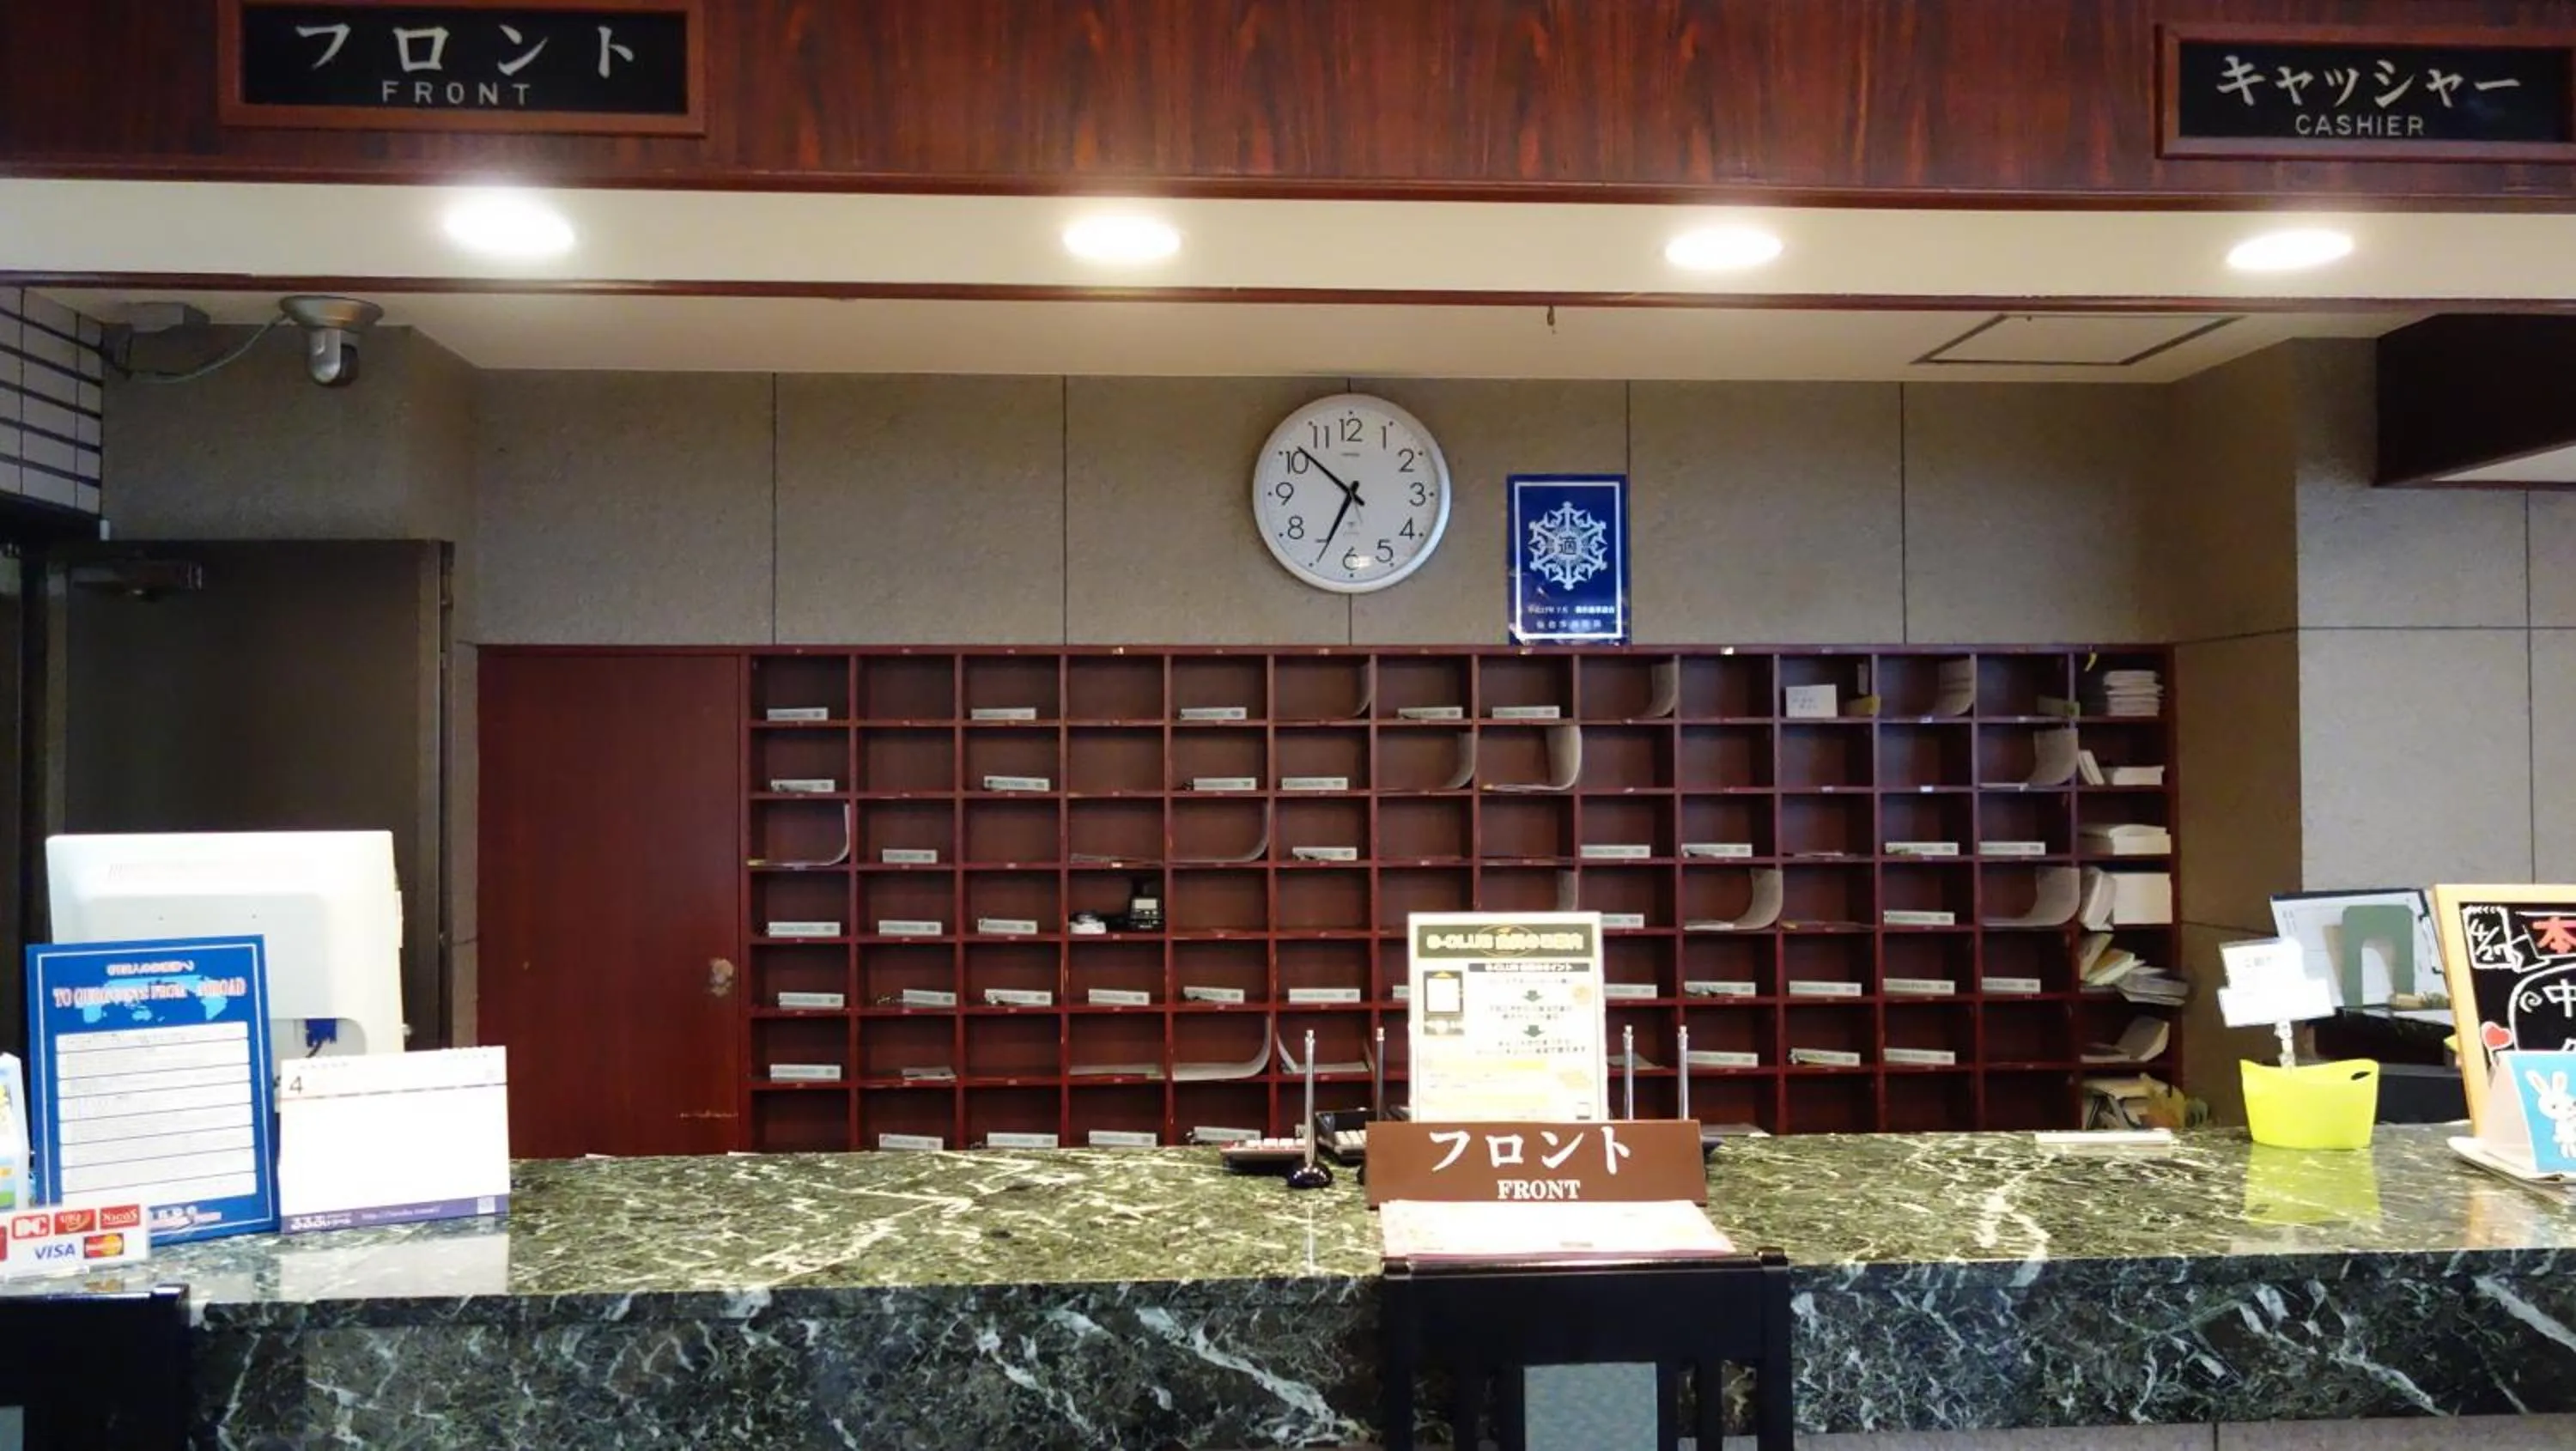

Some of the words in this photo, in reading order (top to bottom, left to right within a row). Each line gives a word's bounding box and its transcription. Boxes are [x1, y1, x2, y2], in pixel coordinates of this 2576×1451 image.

[294, 24, 635, 78] フロント
[381, 80, 532, 106] FRONT
[2215, 54, 2522, 109] キャッシャー
[2293, 112, 2426, 137] CASHIER
[1312, 425, 1330, 449] 11
[1339, 417, 1363, 442] 12
[1380, 425, 1388, 450] 1
[1285, 449, 1309, 475] 10
[1397, 448, 1415, 472] 2
[1274, 482, 1294, 506] 9
[1408, 482, 1426, 507] 3
[1287, 514, 1304, 540] 8
[1399, 517, 1415, 540] 4
[1342, 546, 1362, 571] 6
[1375, 538, 1394, 563] 5
[289, 1075, 303, 1095] 4
[1429, 1126, 1630, 1175] フロント
[1497, 1179, 1581, 1200] FRONT
[15, 1217, 48, 1237] DC
[34, 1243, 76, 1260] VISA
